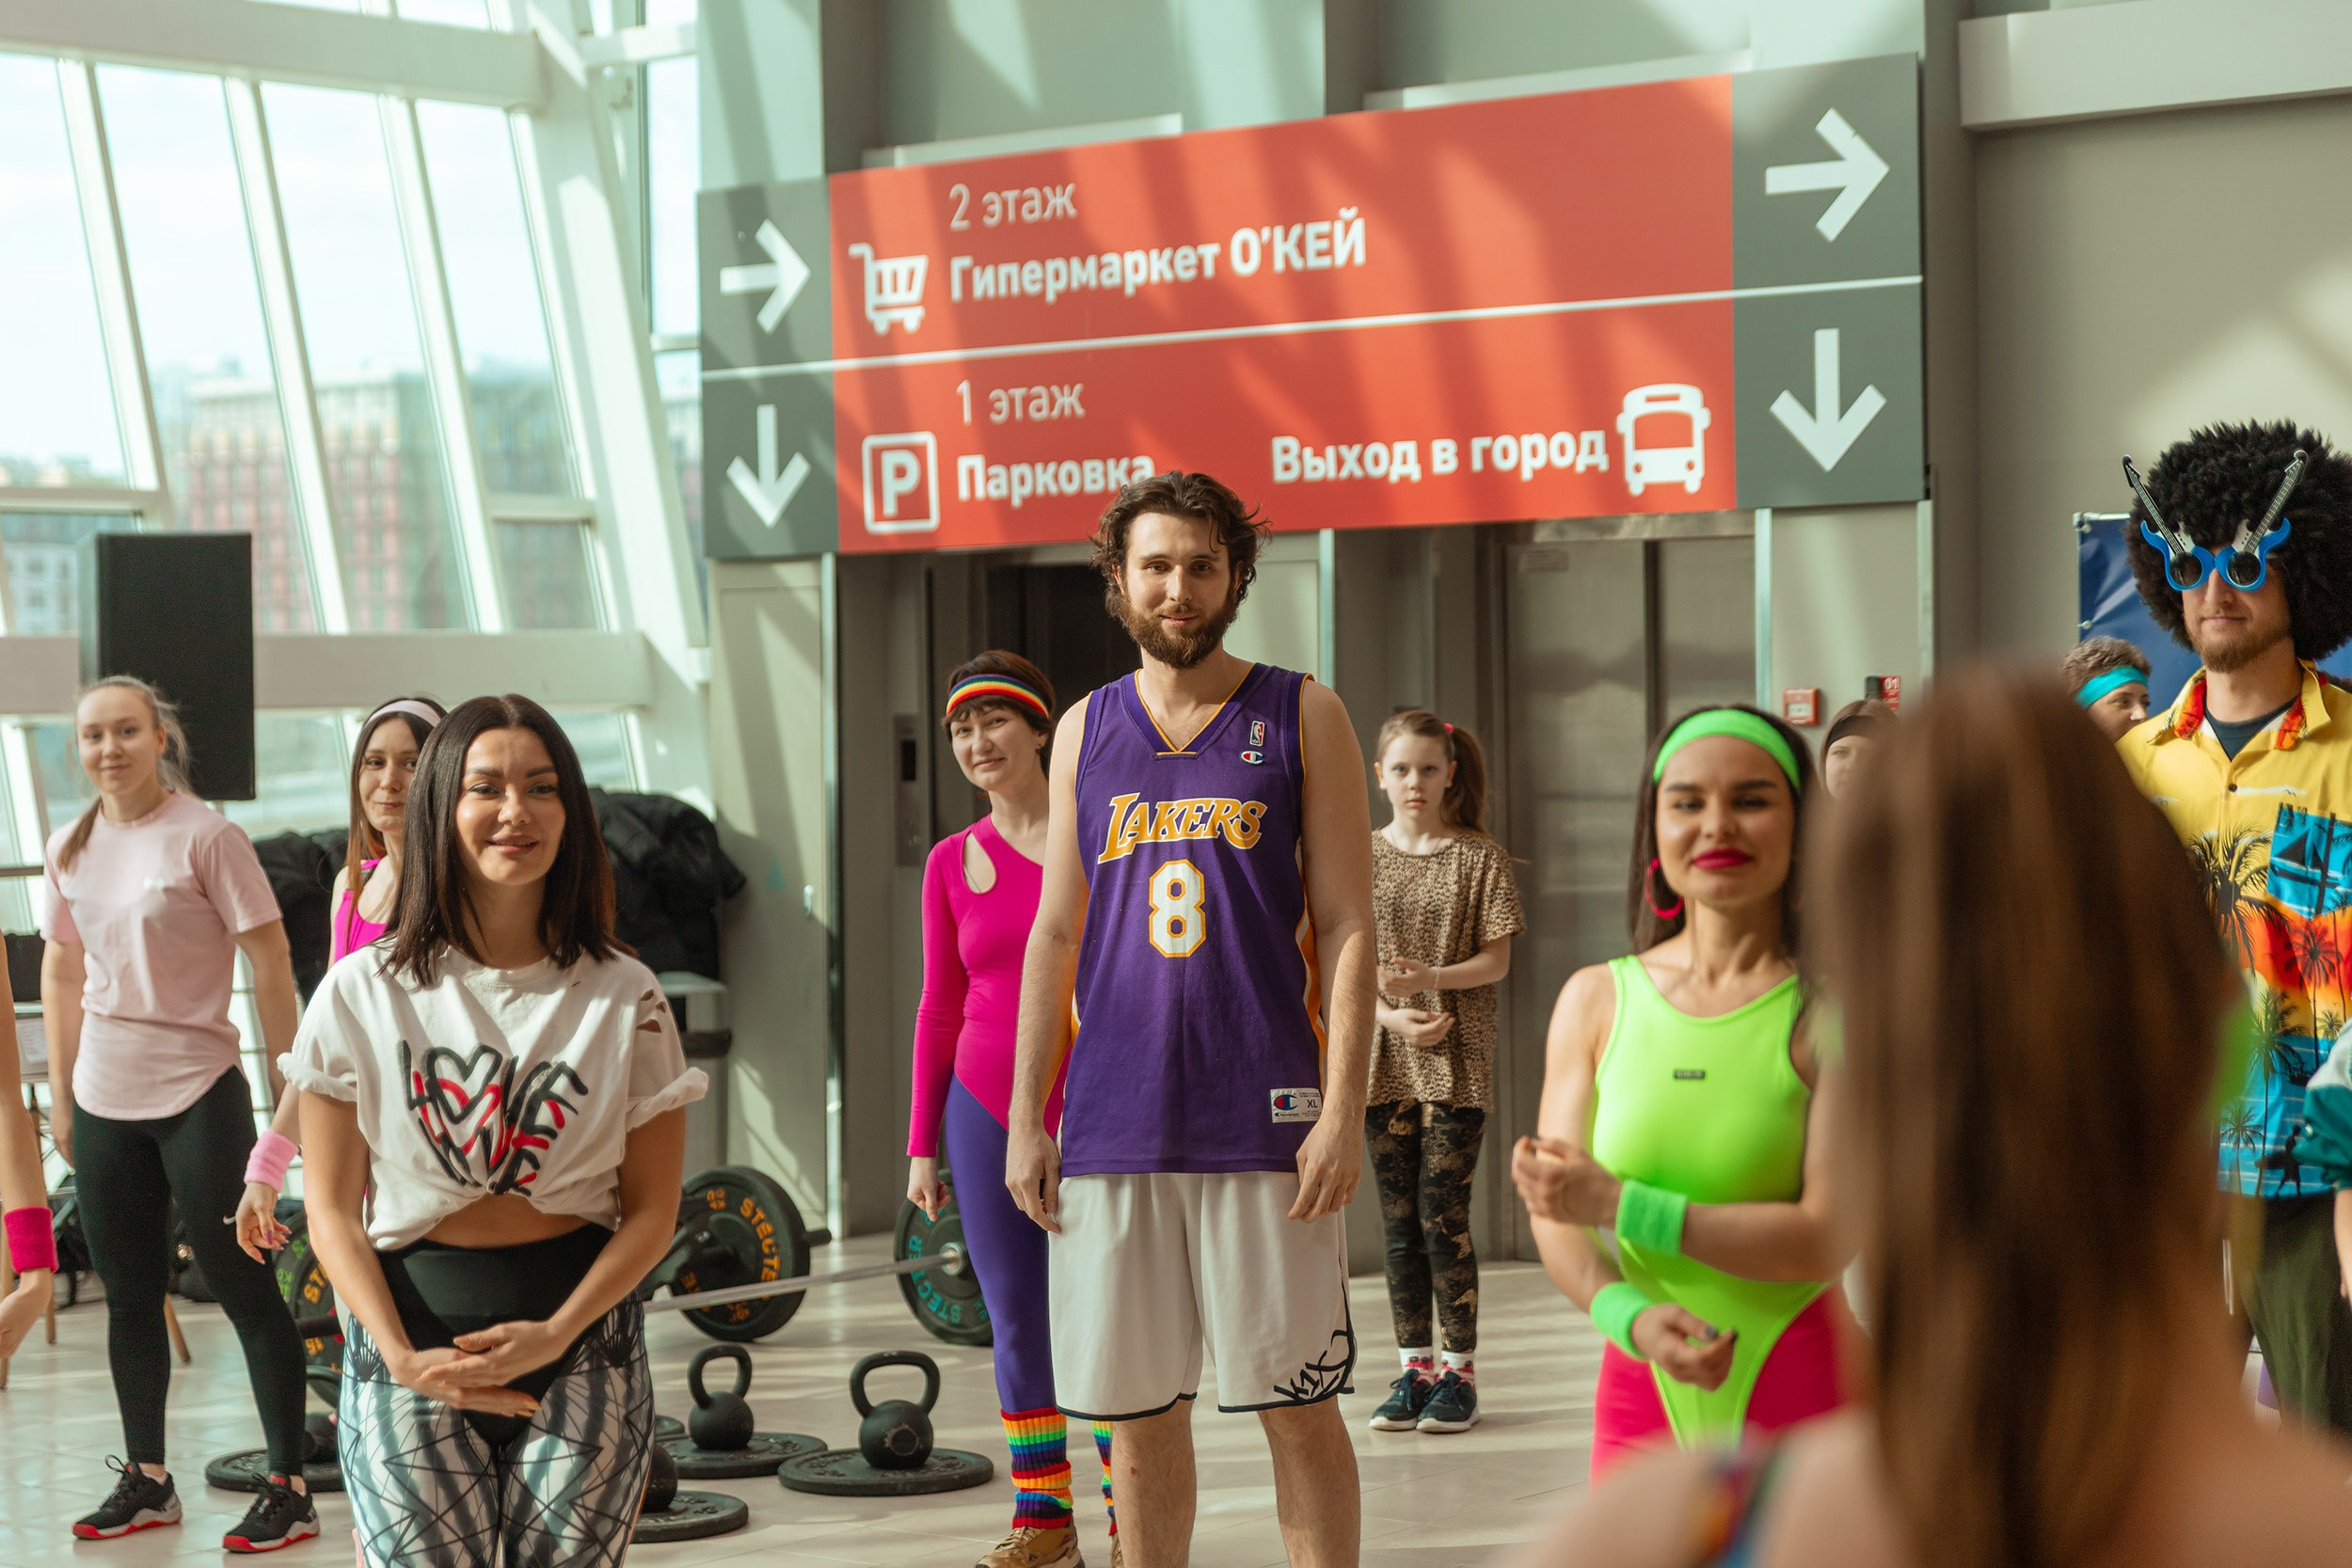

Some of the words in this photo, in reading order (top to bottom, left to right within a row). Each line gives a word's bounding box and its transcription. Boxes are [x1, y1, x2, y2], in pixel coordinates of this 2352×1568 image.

[949, 183, 971, 231] 2
[981, 182, 1078, 228] этаж
[950, 242, 1221, 304] Гипермаркет
[957, 379, 972, 426] 1
[989, 382, 1086, 426] этаж
[957, 453, 1155, 509] Парковка
[1271, 435, 1422, 484] Выход
[1431, 437, 1459, 475] в
[1470, 429, 1610, 482] город
[1149, 859, 1206, 958] 8
[1307, 1099, 1318, 1109] XL
[739, 1196, 781, 1302] STECTE
